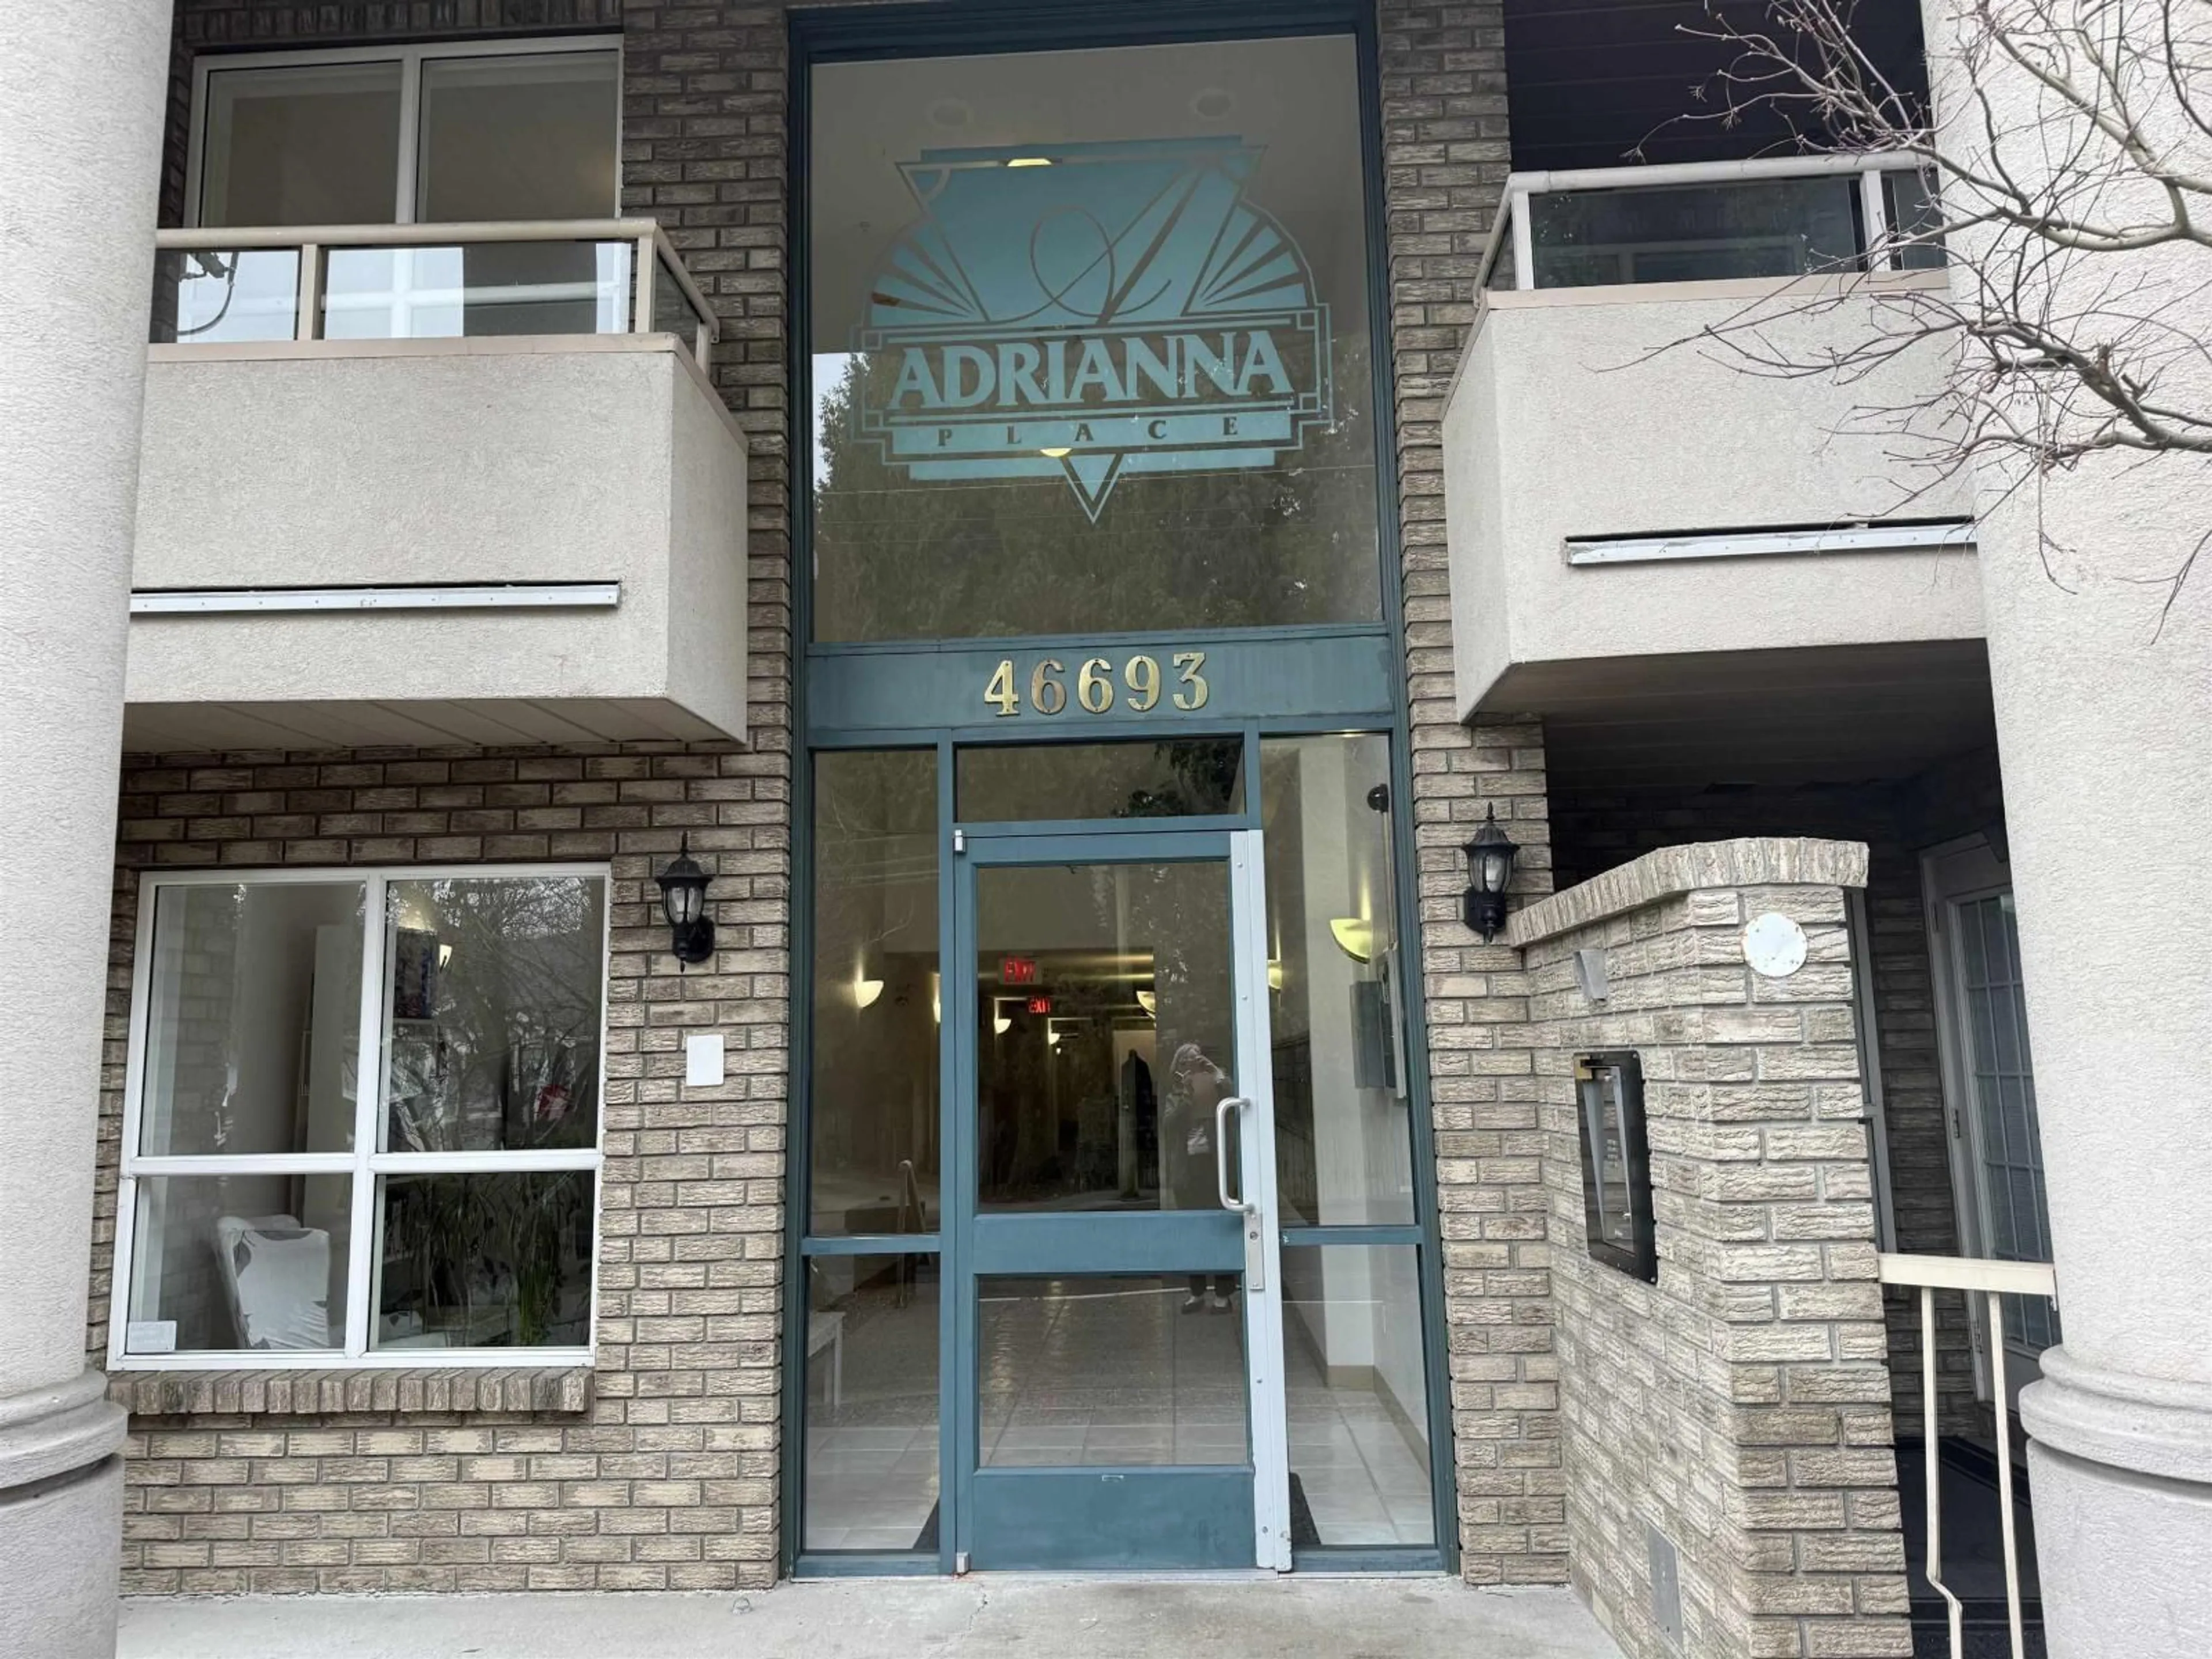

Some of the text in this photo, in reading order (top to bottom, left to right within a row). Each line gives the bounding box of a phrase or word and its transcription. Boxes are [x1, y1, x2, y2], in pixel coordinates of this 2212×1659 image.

[889, 330, 1294, 411] ADRIANNA
[938, 416, 1238, 447] PLACE
[984, 652, 1209, 716] 46693
